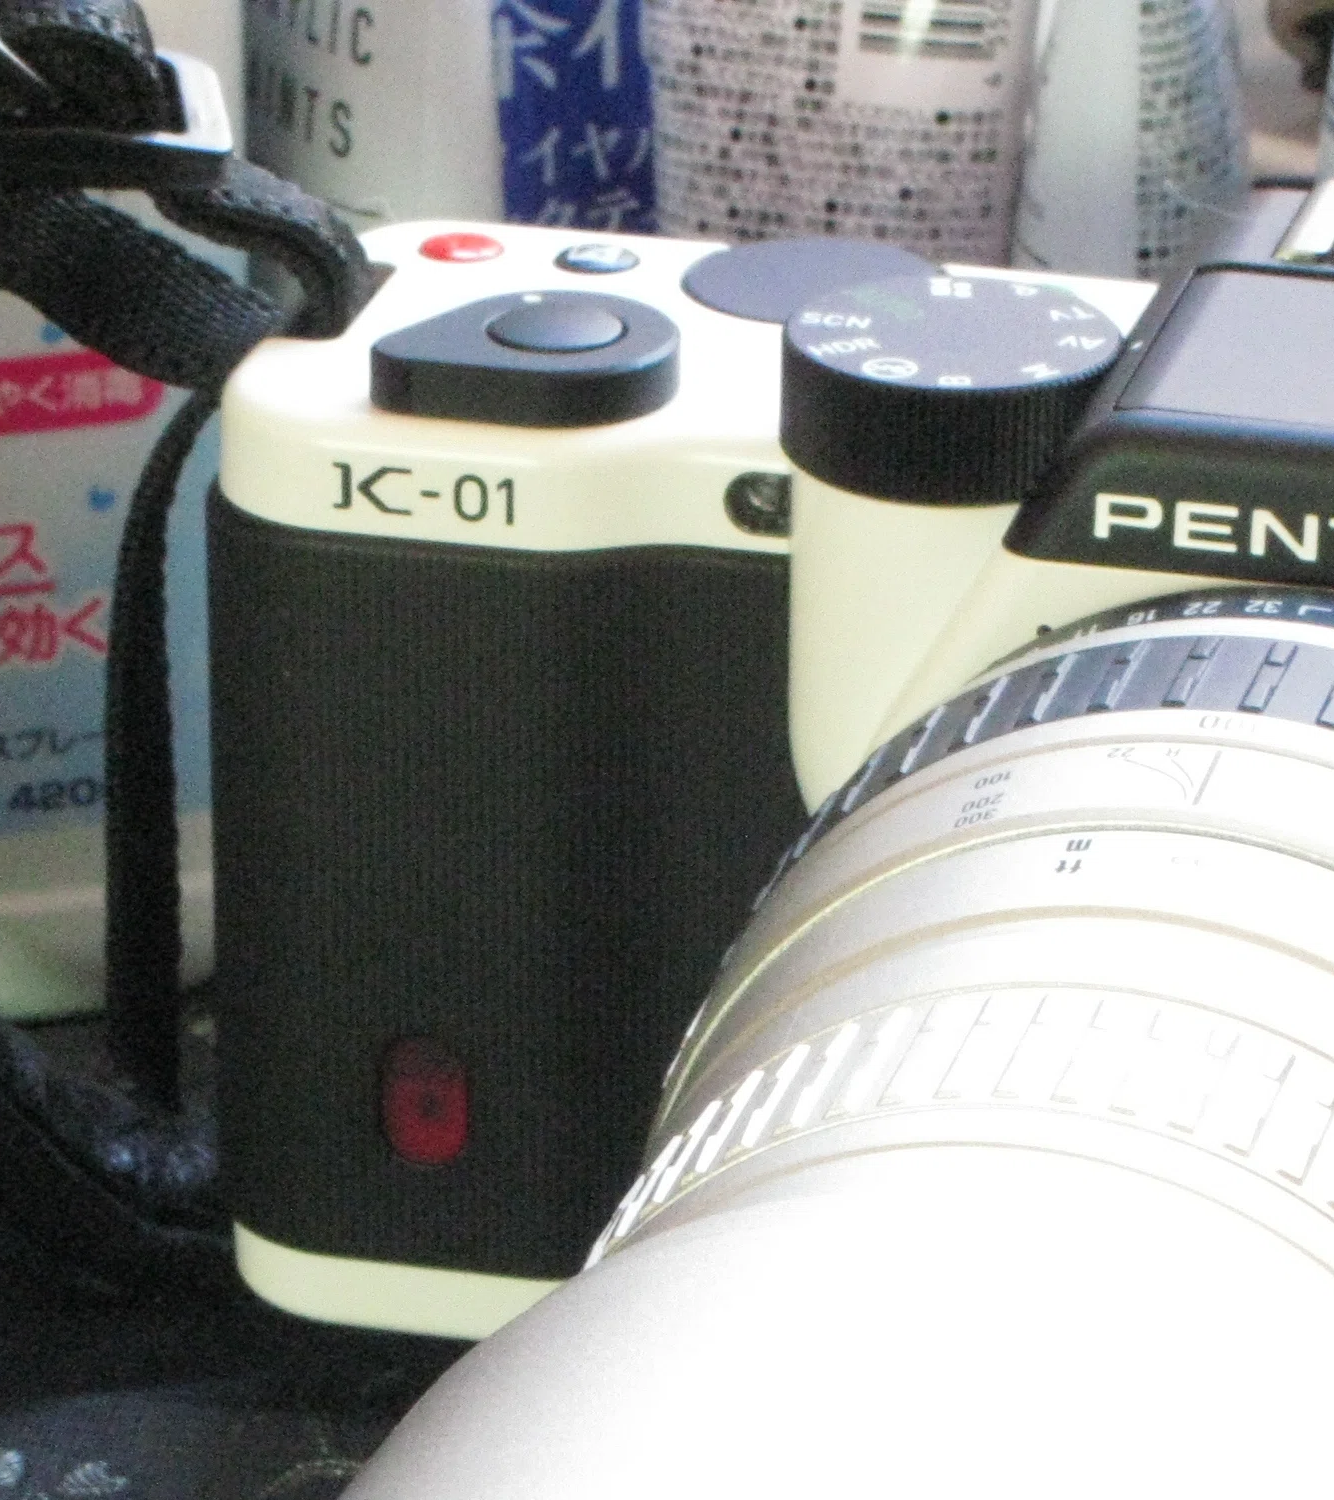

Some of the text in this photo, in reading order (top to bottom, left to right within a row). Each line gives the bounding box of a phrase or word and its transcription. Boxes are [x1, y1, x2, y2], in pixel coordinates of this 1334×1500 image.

[800, 311, 872, 329] SCN
[807, 335, 884, 357] HDR
[332, 461, 516, 526] K-01
[1182, 600, 1222, 616] 22
[1244, 600, 1283, 614] 32
[974, 771, 1012, 790] 100
[961, 792, 1005, 814] 200
[953, 808, 999, 829] 300
[1054, 859, 1083, 874] ft
